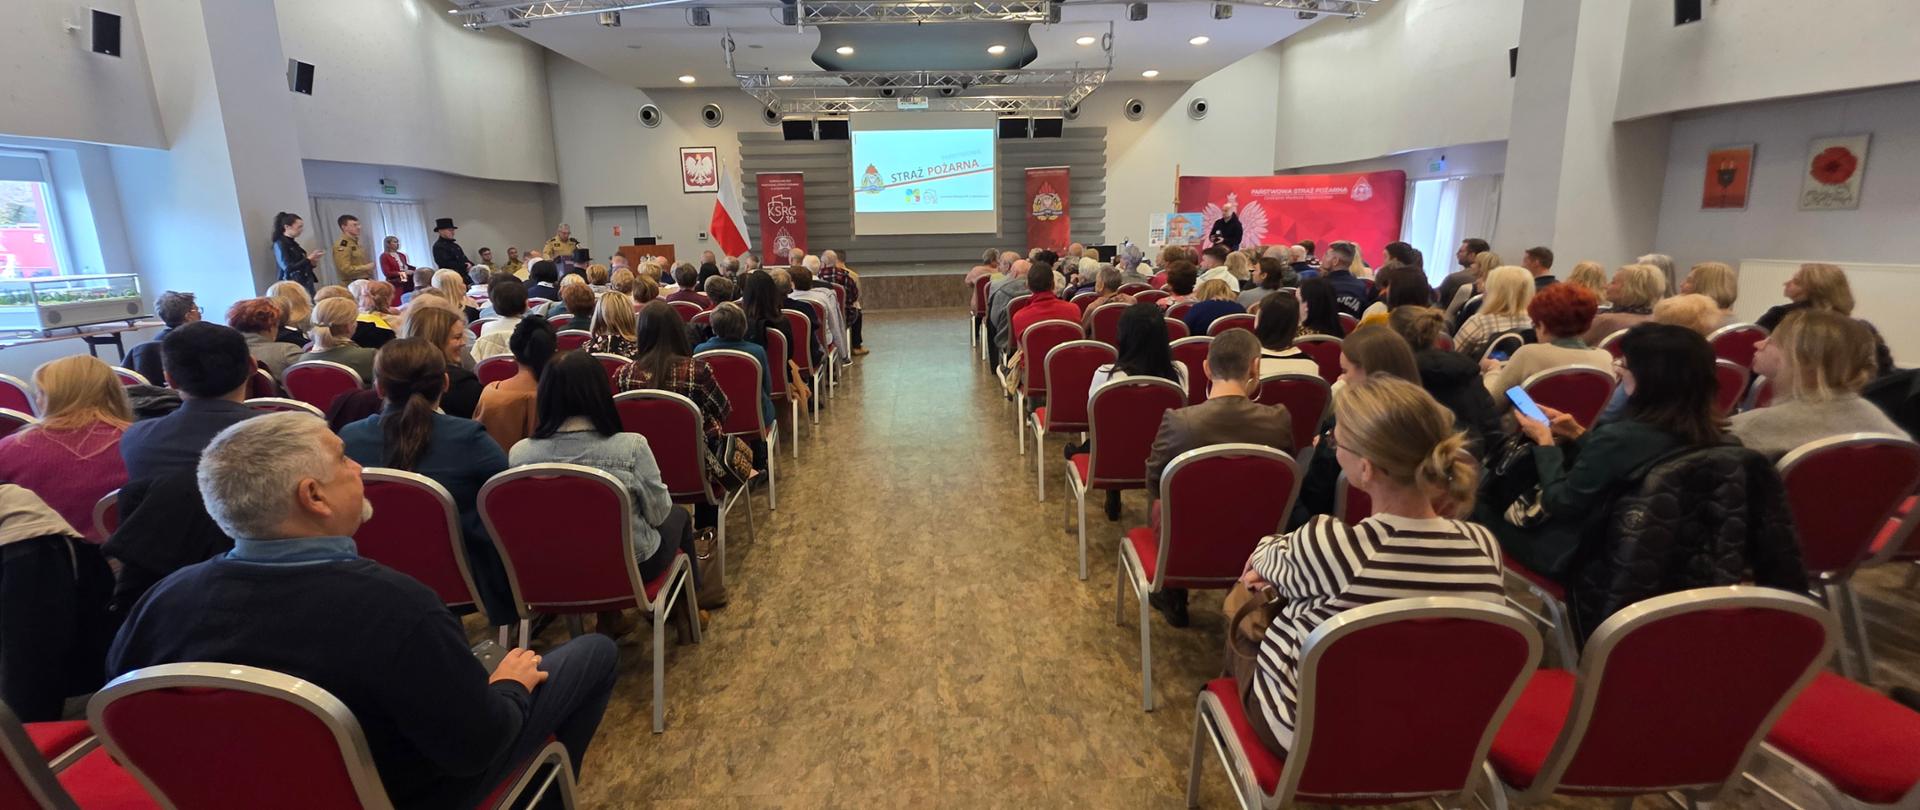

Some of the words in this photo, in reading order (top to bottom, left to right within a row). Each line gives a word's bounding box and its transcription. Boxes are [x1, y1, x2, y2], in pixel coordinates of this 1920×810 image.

[890, 166, 924, 183] STRAŻ
[927, 159, 980, 176] POŻARNA
[767, 206, 797, 217] KSRG
